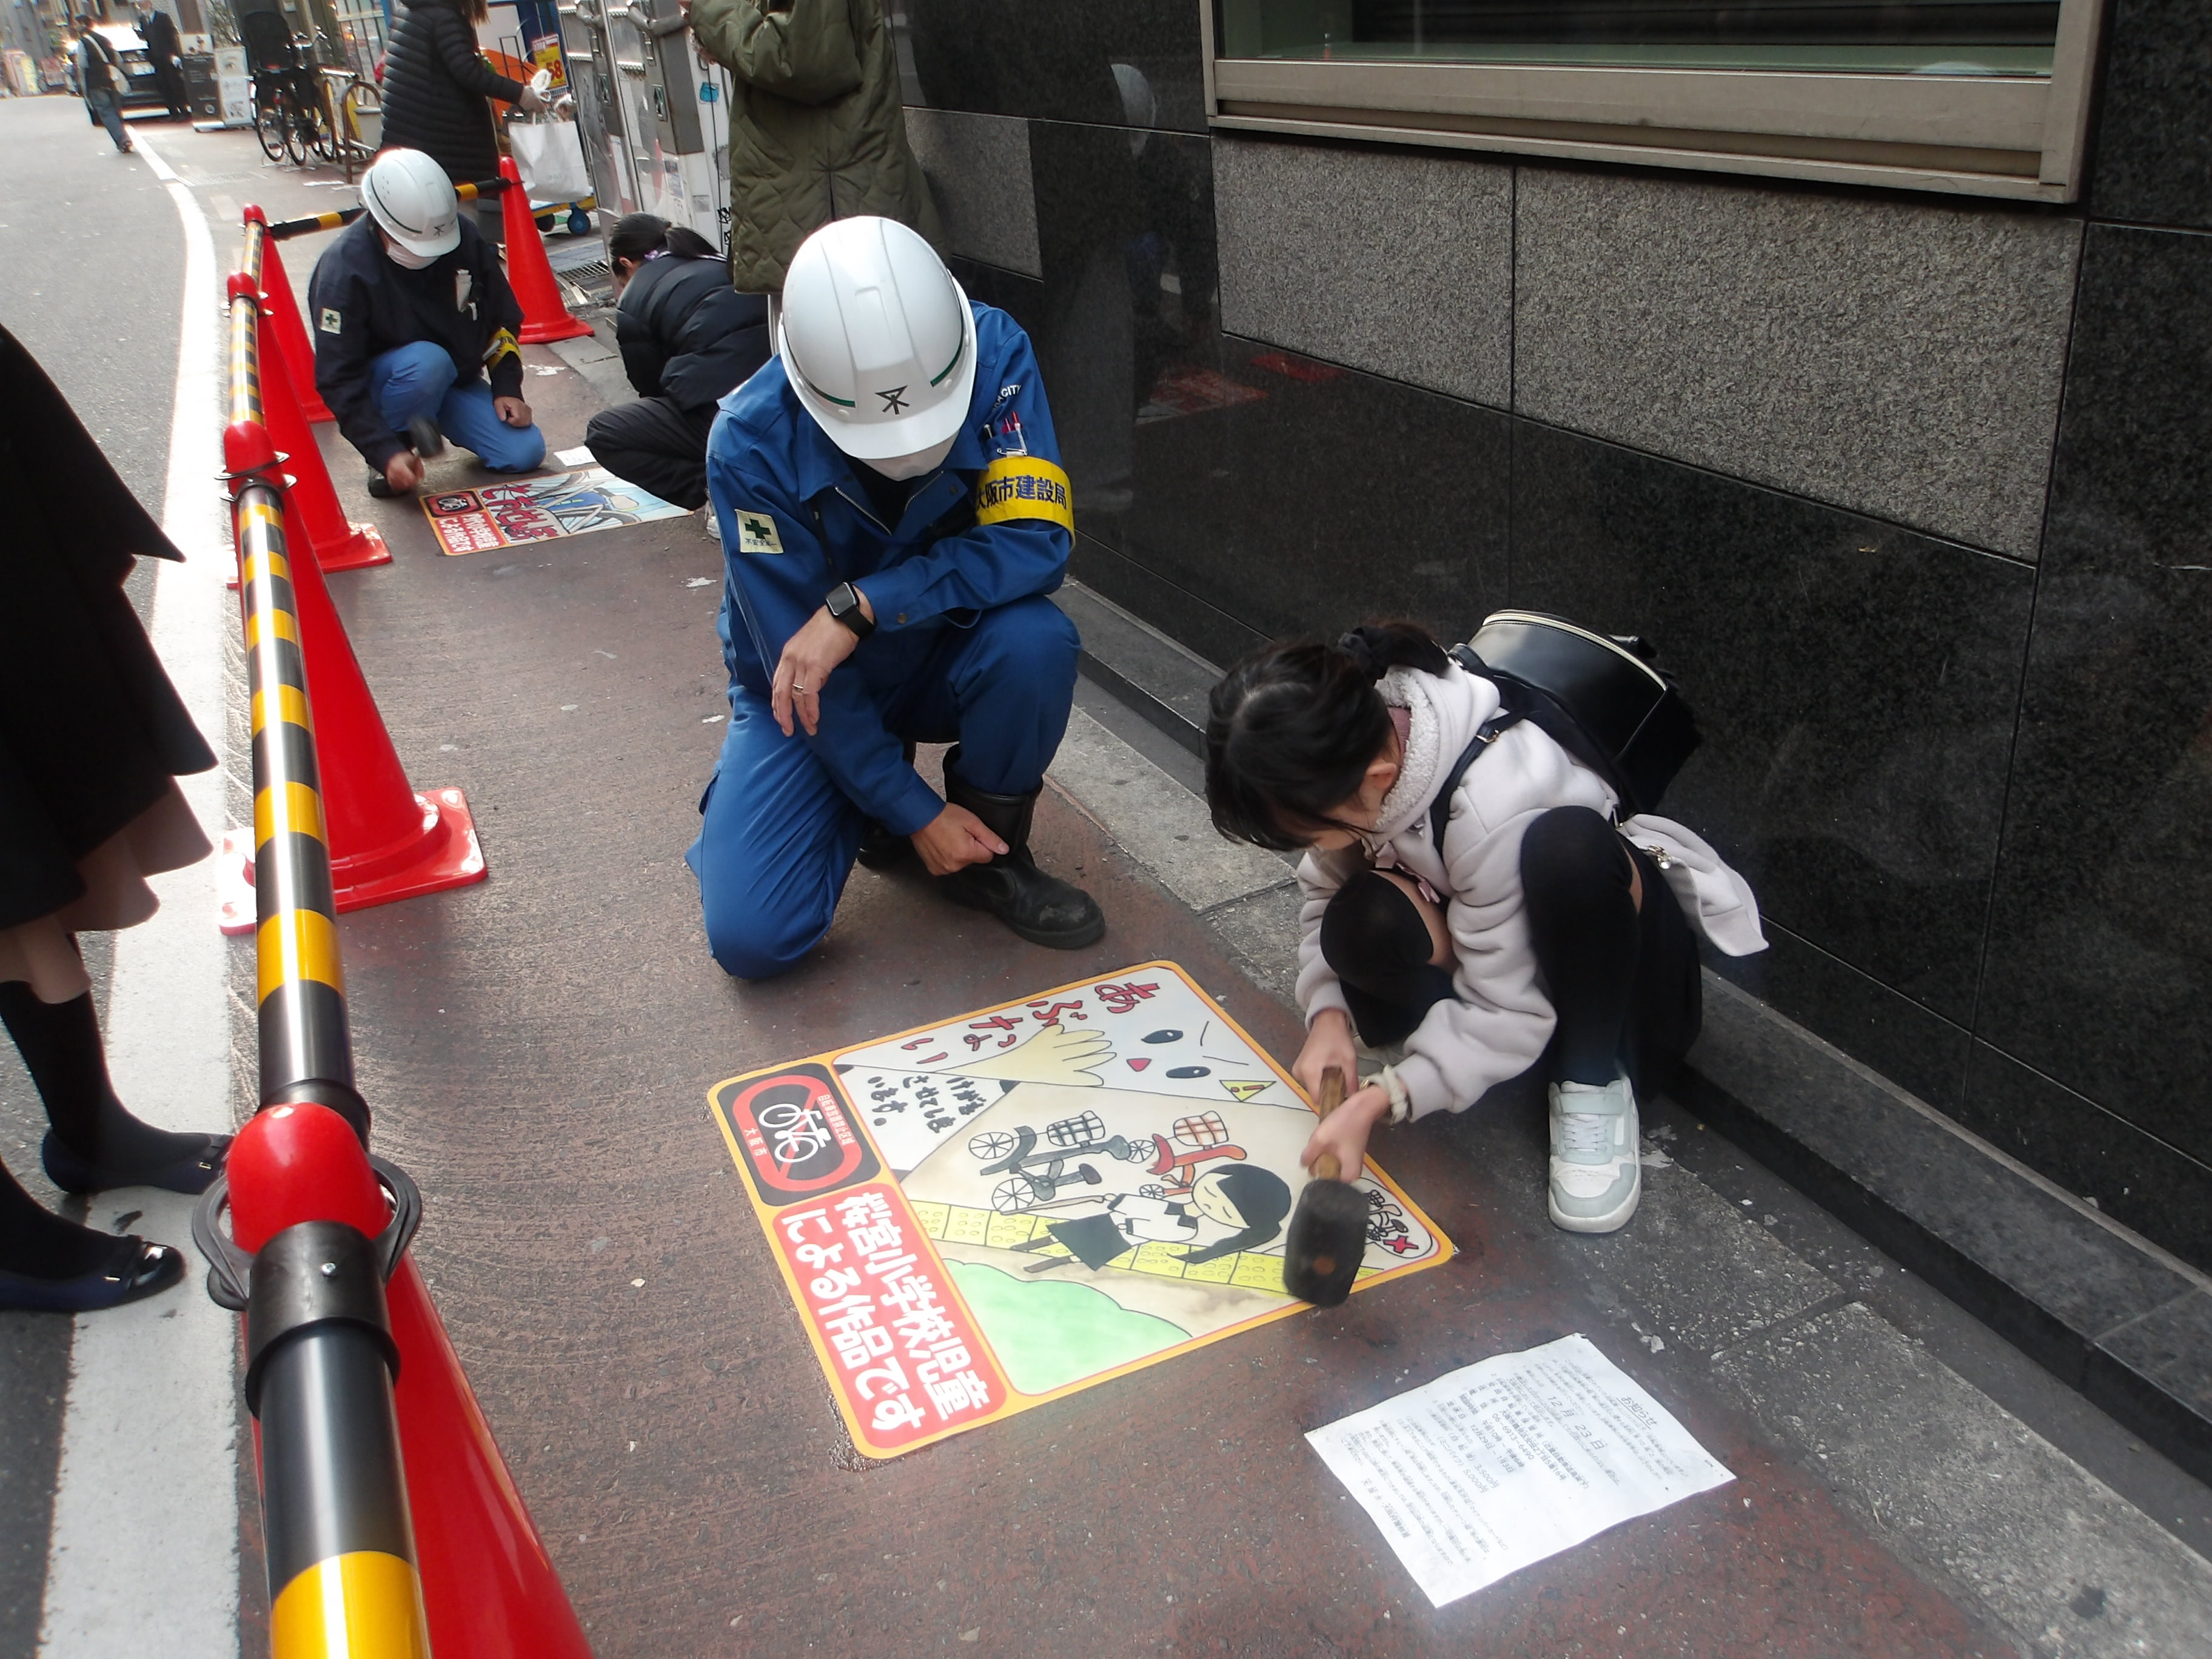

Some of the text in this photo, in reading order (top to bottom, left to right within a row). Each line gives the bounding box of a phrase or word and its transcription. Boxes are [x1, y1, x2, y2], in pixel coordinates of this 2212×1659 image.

[902, 981, 1161, 1064] あぶない
[743, 1127, 769, 1157] 大阪市
[816, 1093, 851, 1147] 自転車放置禁止区域
[781, 1210, 926, 1430] による作品です
[834, 1191, 989, 1420] 桜宮小学校児童
[1620, 1395, 1660, 1427] お知らせ
